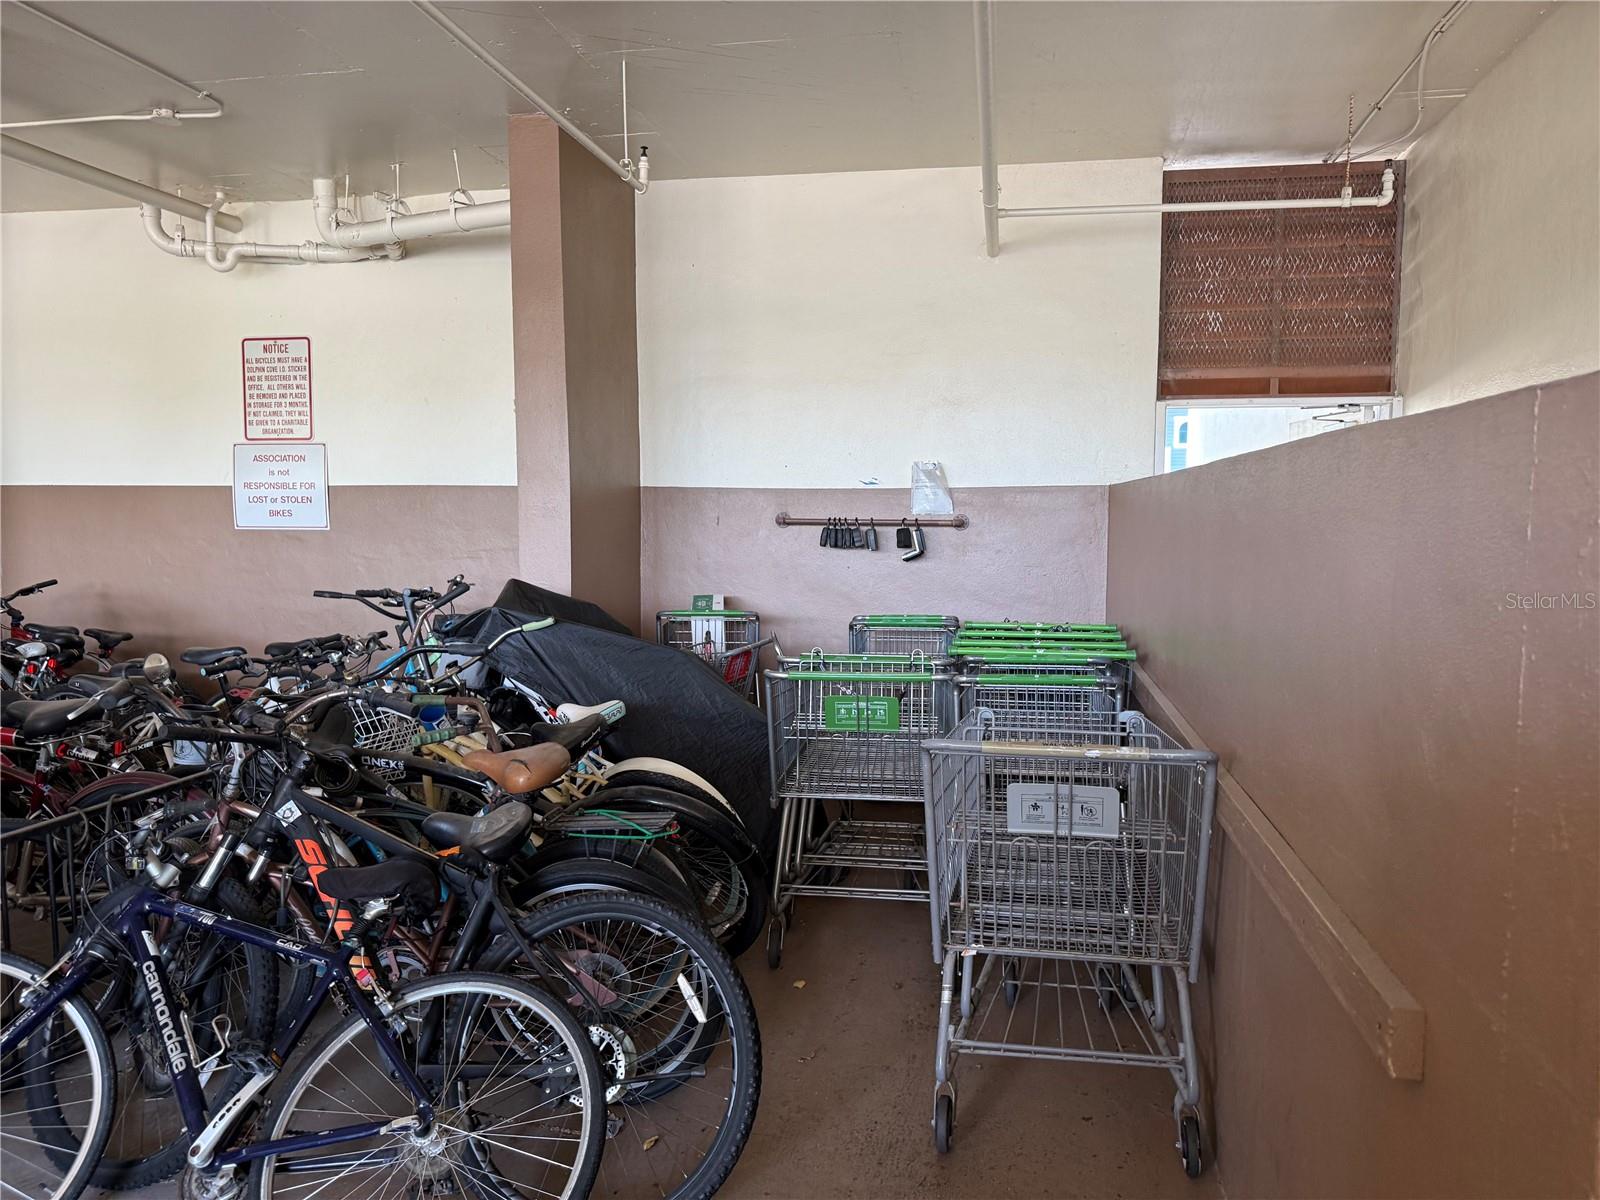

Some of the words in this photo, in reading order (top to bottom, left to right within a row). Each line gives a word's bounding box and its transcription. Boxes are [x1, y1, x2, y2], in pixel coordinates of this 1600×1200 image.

[263, 344, 289, 353] NOTICE
[253, 454, 306, 462] ASSOCIATION
[269, 468, 275, 476] is
[142, 960, 188, 1074] cannondale
